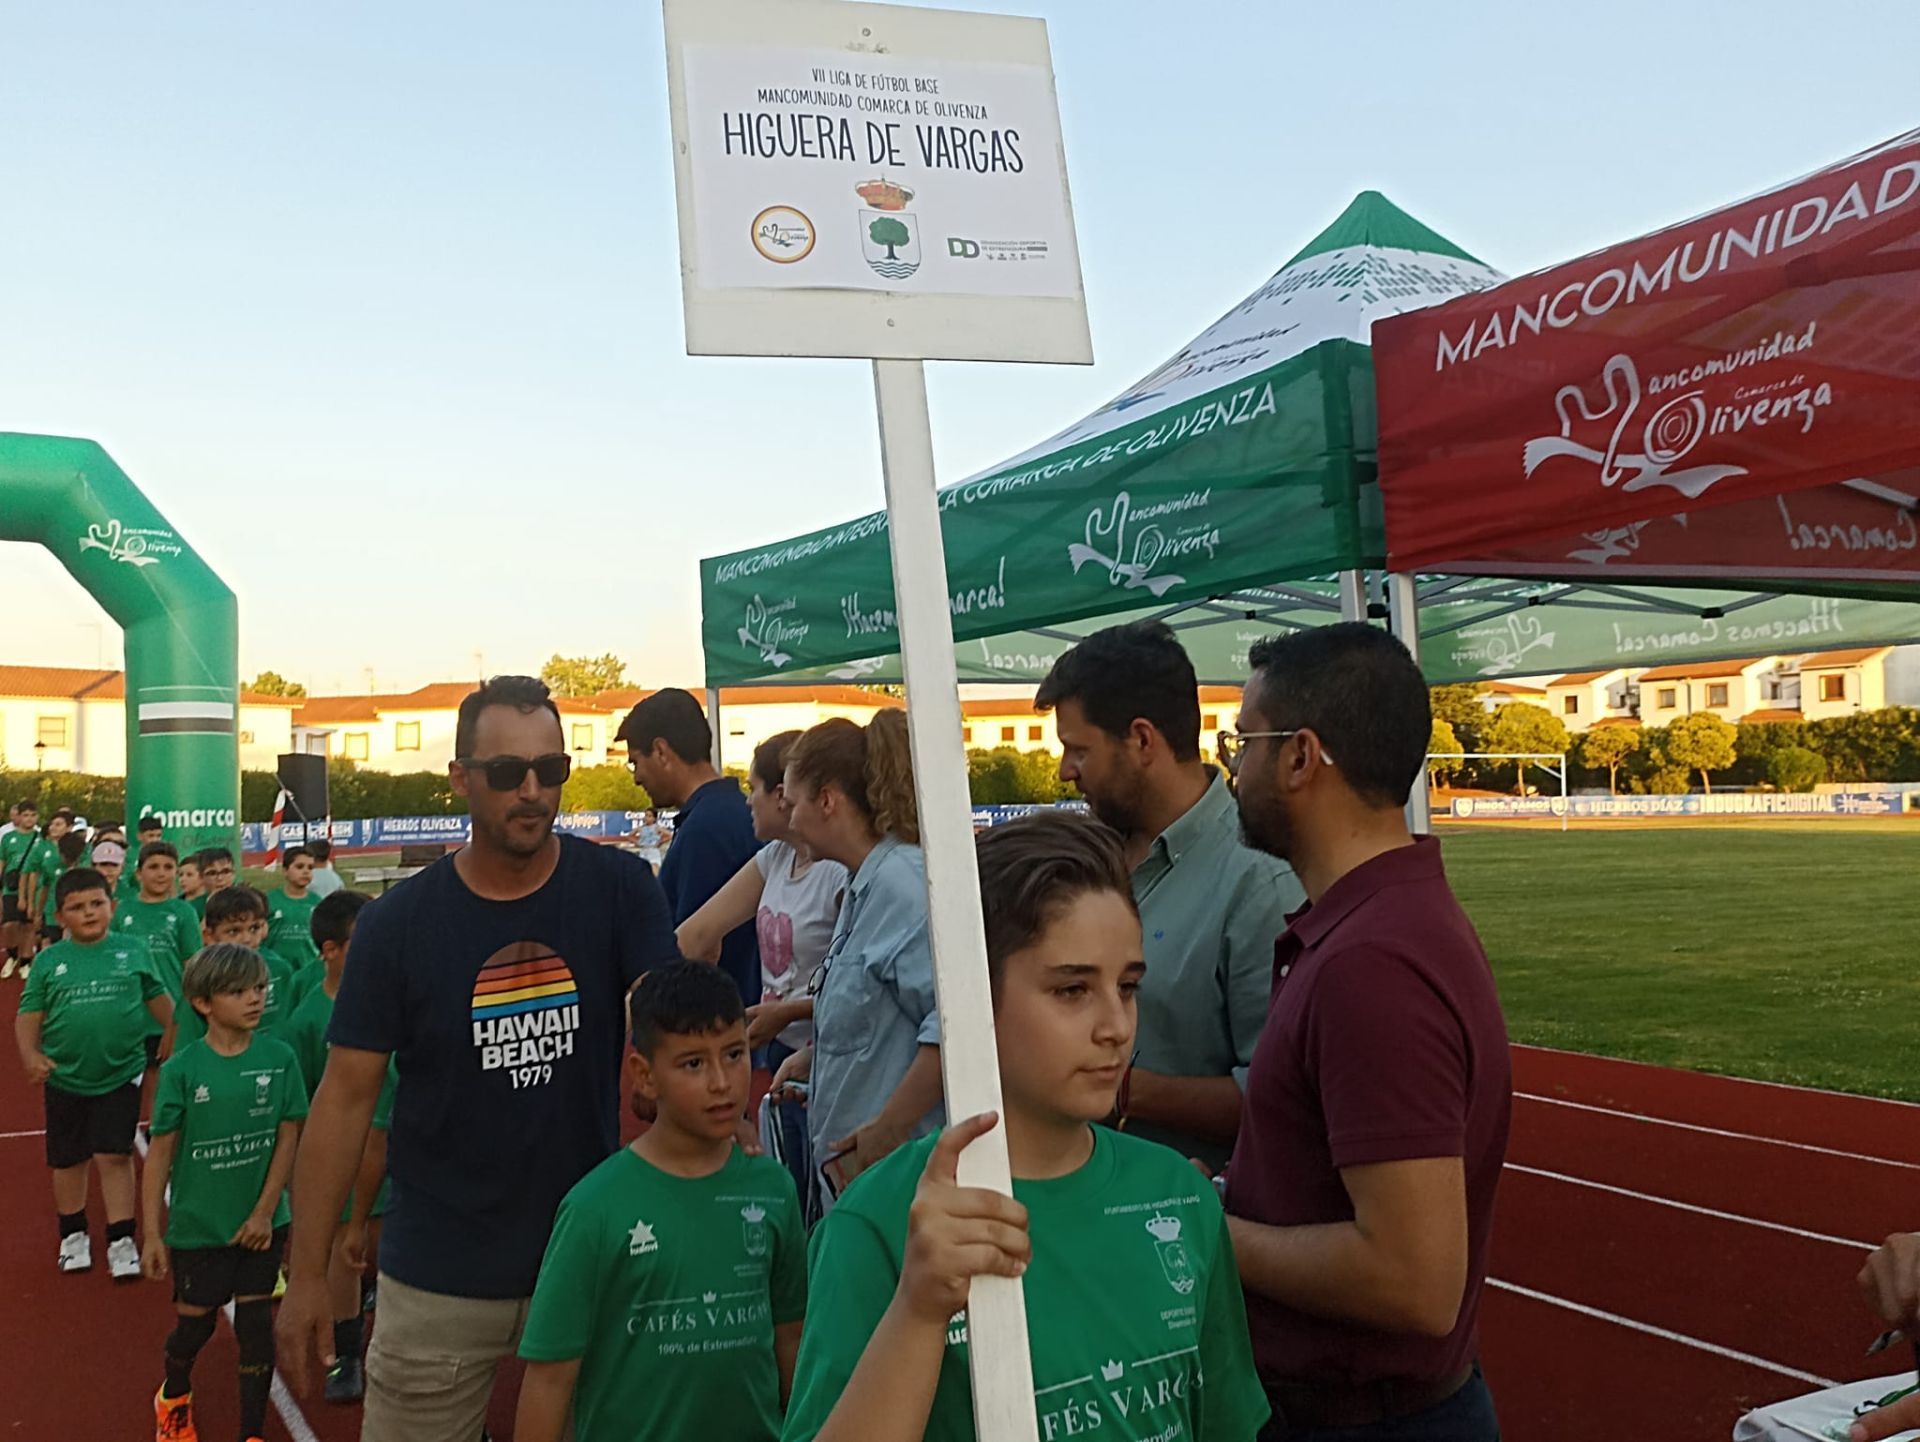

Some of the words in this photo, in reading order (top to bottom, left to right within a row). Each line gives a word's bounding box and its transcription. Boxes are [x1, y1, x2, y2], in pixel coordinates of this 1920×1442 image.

[811, 67, 826, 83] VII
[829, 70, 851, 86] LIGA
[854, 74, 868, 89] DE
[871, 73, 911, 93] FÚTBOL
[915, 78, 940, 95] BASE
[757, 88, 853, 109] MANCOMUNIDAD
[857, 95, 911, 115] COMARCA
[915, 100, 929, 116] DE
[934, 101, 988, 120] OLIVENZA
[723, 112, 856, 162] HIGUERA
[866, 121, 906, 166] DE
[916, 124, 1024, 174] VARGAS
[1434, 159, 1920, 372] MANCOMUNIDAD
[828, 511, 890, 548] INTEGR
[1126, 381, 1277, 455] OLIVENZA
[840, 592, 898, 639] ¡Hacem
[420, 817, 462, 831] OLIVENZA
[473, 1004, 580, 1047] HAWAII
[482, 1032, 574, 1070] BEACH
[509, 1064, 553, 1089] 1979
[626, 1307, 697, 1335] CAFÉS
[1041, 1398, 1102, 1442] FÉS
